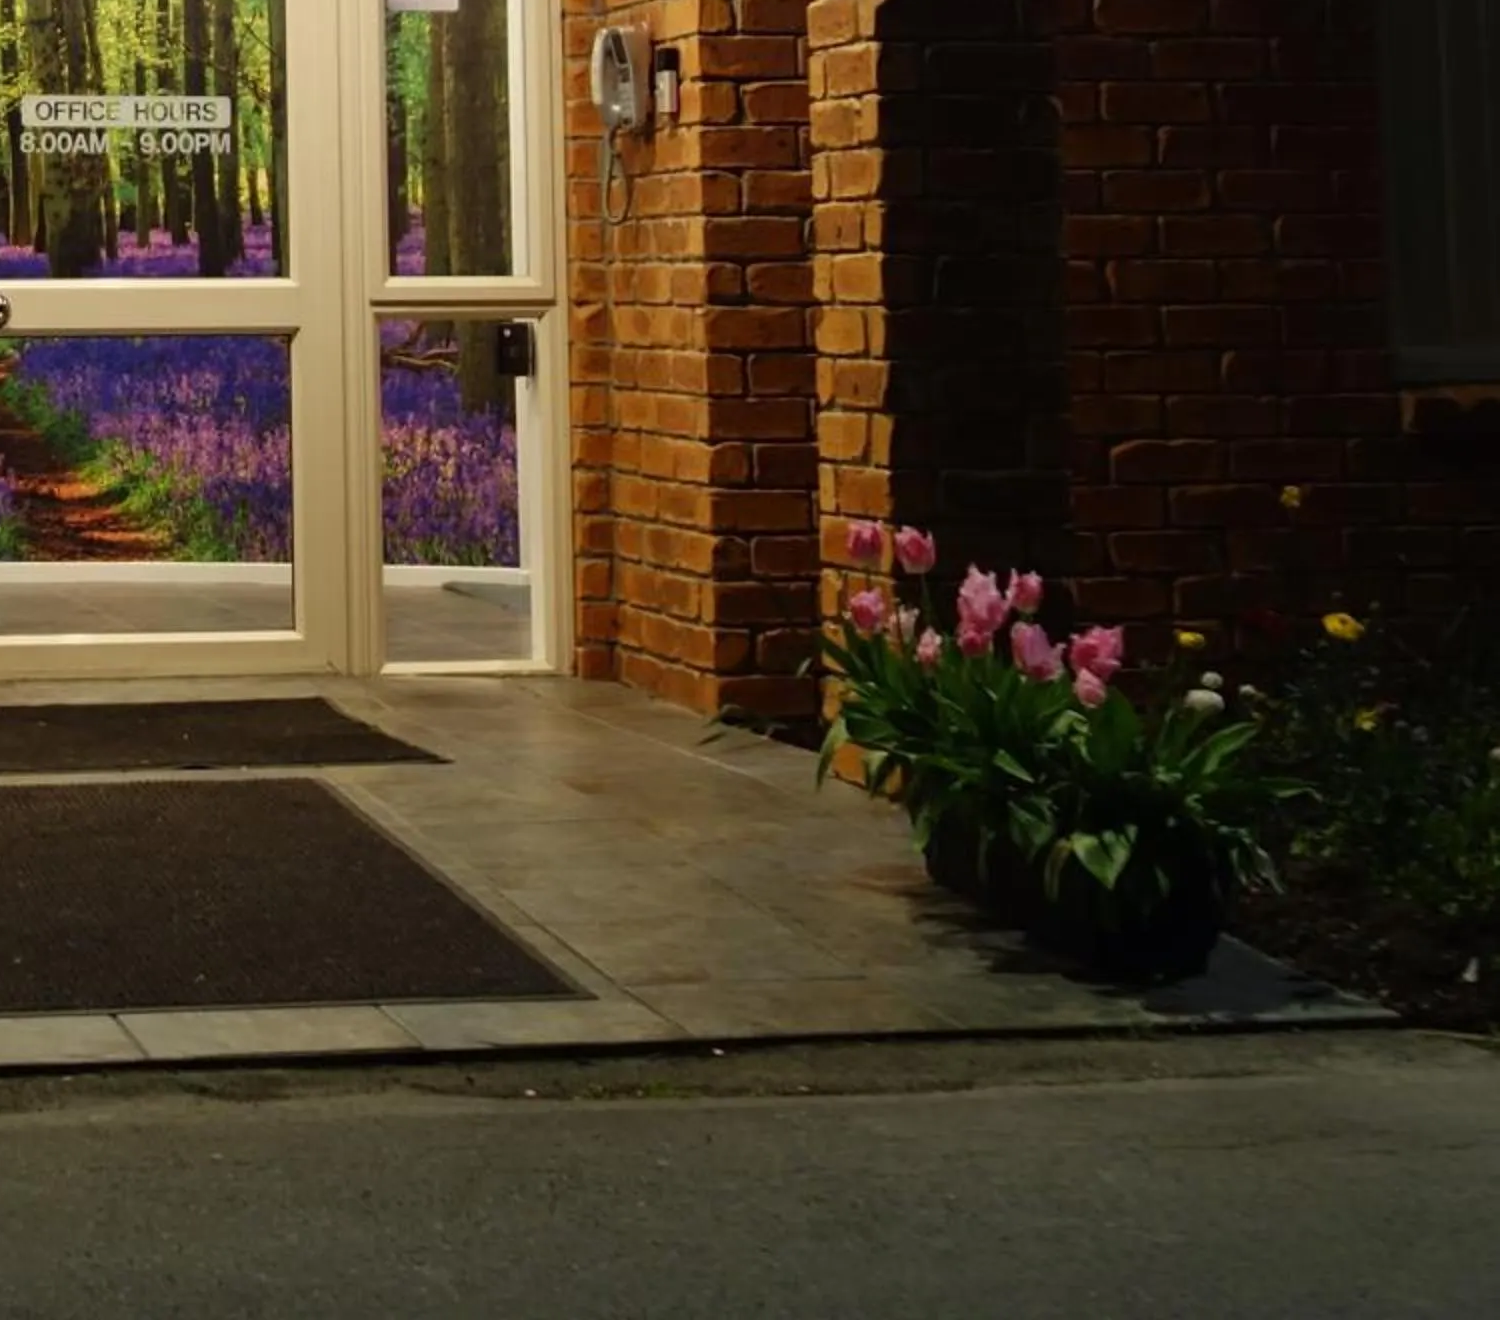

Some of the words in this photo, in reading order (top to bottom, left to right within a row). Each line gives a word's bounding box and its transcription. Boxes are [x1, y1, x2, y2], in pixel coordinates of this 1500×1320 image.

[35, 101, 121, 122] OFFICE
[134, 101, 218, 122] HOURS
[20, 132, 109, 154] 8.00AM
[140, 132, 231, 154] 9.00PM
